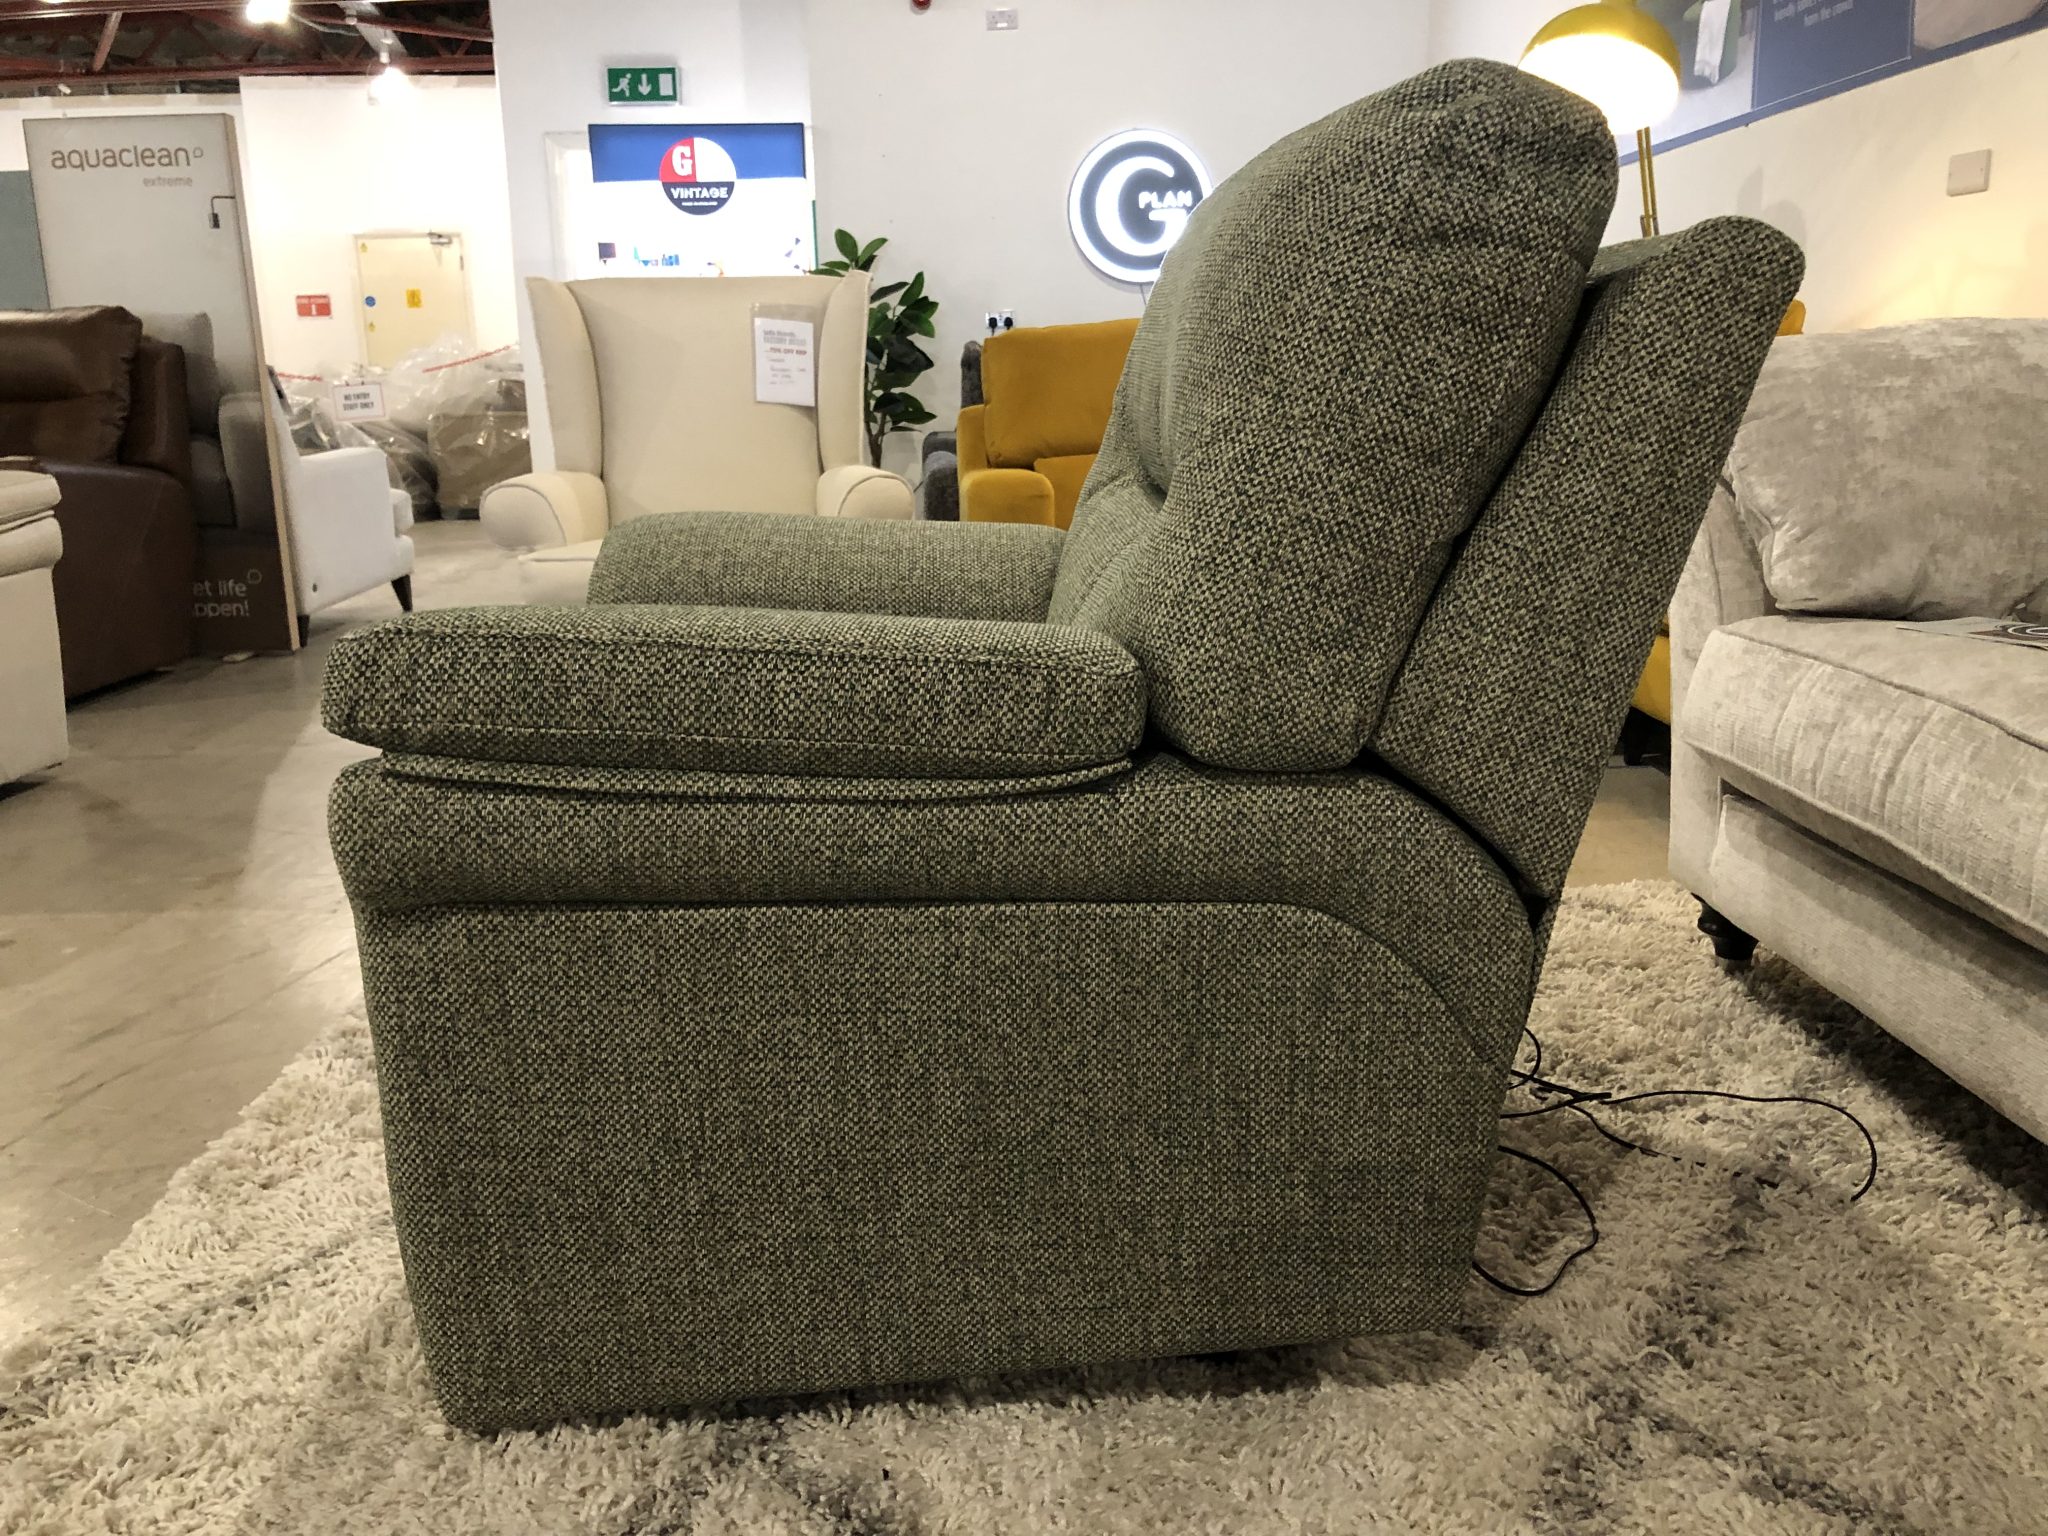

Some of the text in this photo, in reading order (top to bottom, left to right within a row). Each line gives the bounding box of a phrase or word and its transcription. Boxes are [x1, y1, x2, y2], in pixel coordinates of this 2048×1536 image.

[51, 145, 191, 172] aquaclean
[672, 145, 693, 177] G
[142, 175, 193, 187] extreme
[670, 187, 729, 199] VINTAGE
[1138, 190, 1193, 209] PLAN
[1095, 156, 1188, 257] G
[193, 578, 248, 597] et life
